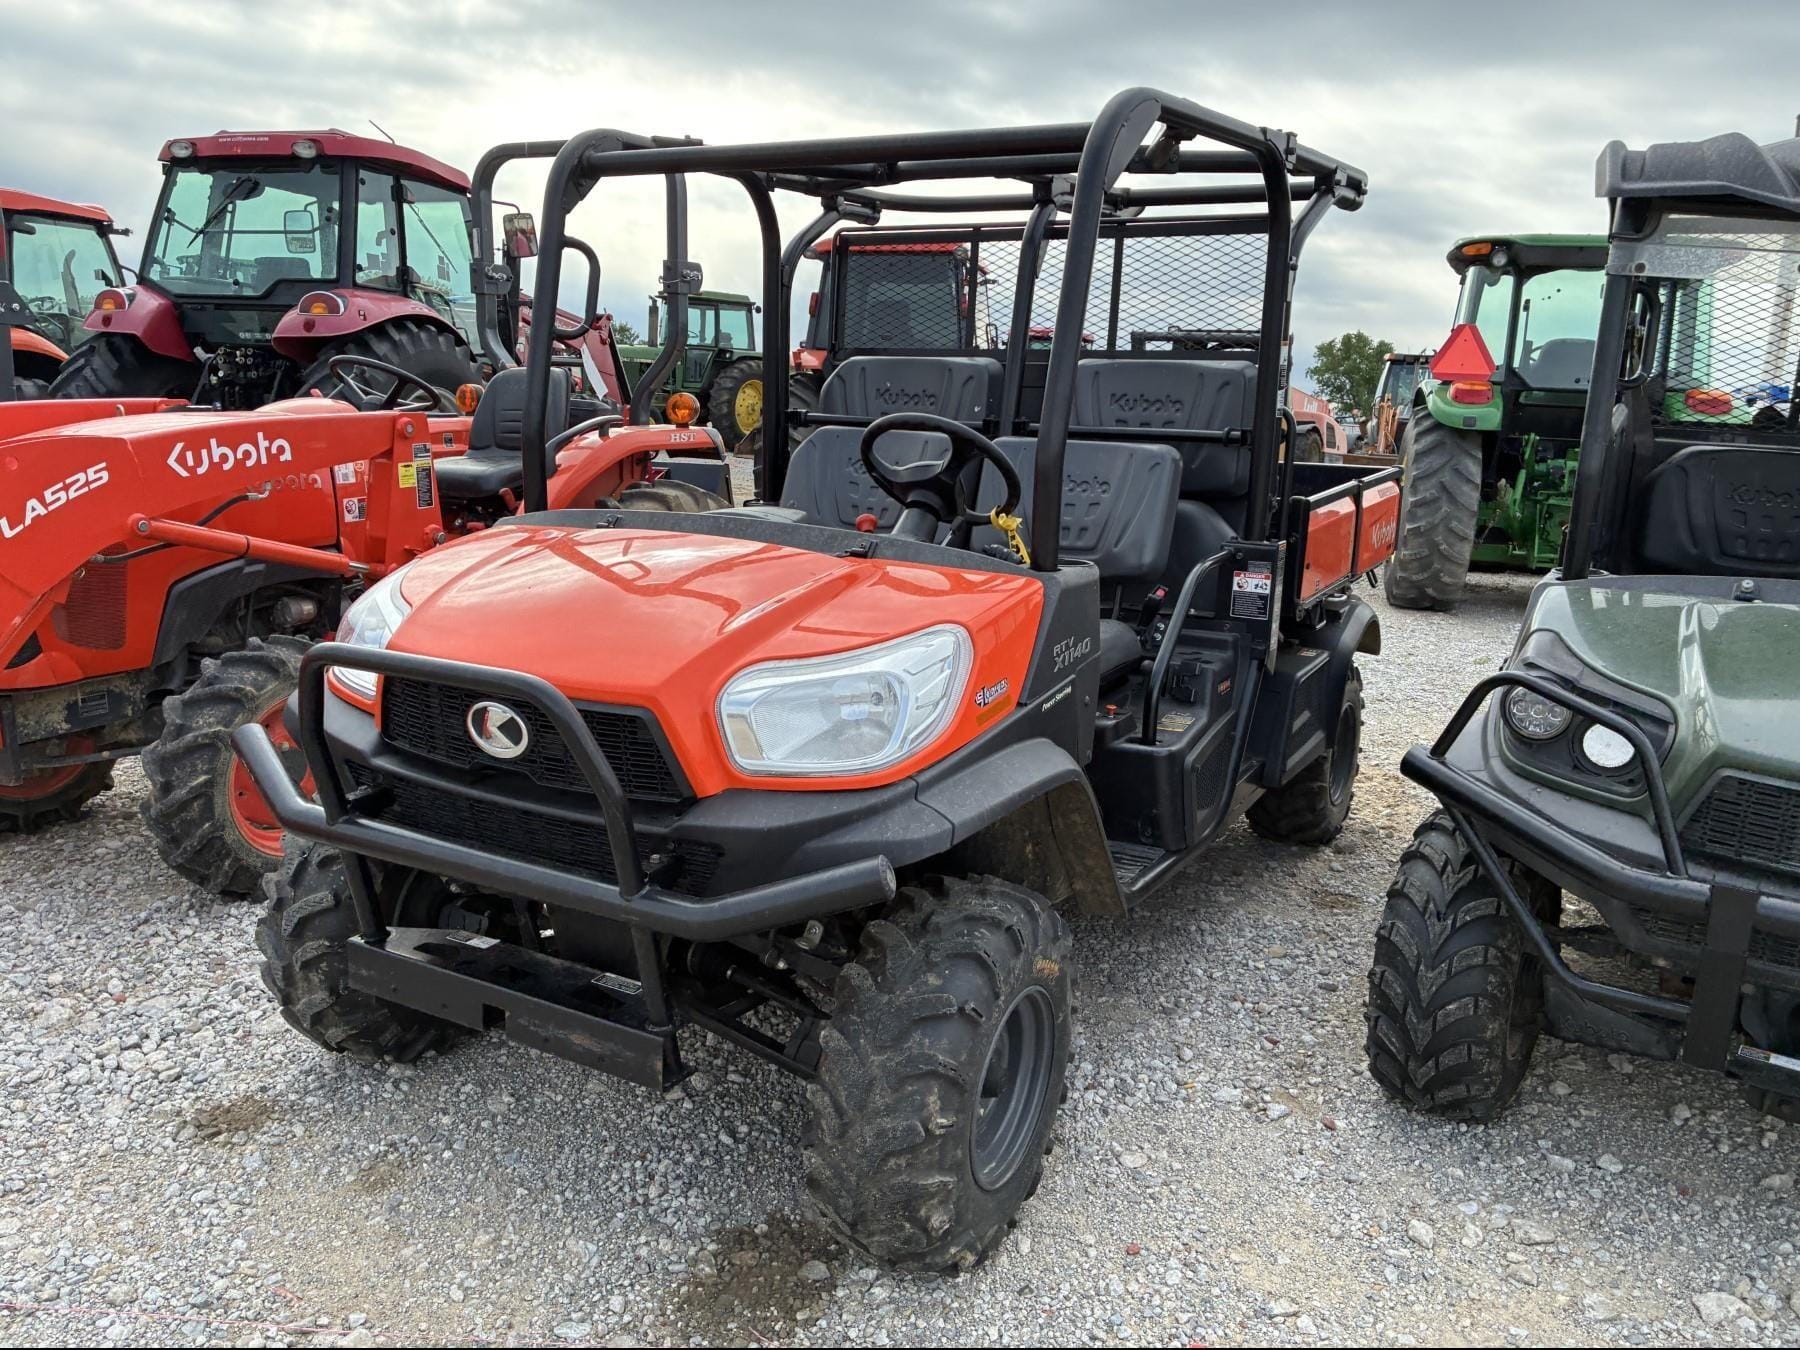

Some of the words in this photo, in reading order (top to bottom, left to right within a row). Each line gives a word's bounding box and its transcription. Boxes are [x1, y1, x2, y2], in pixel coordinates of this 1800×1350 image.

[876, 388, 936, 406] Kubota
[1109, 392, 1184, 414] Kubota
[670, 432, 697, 443] HST
[166, 431, 292, 477] Kubota
[1063, 474, 1112, 497] bota
[0, 461, 109, 539] LA525
[1053, 636, 1074, 656] RTV
